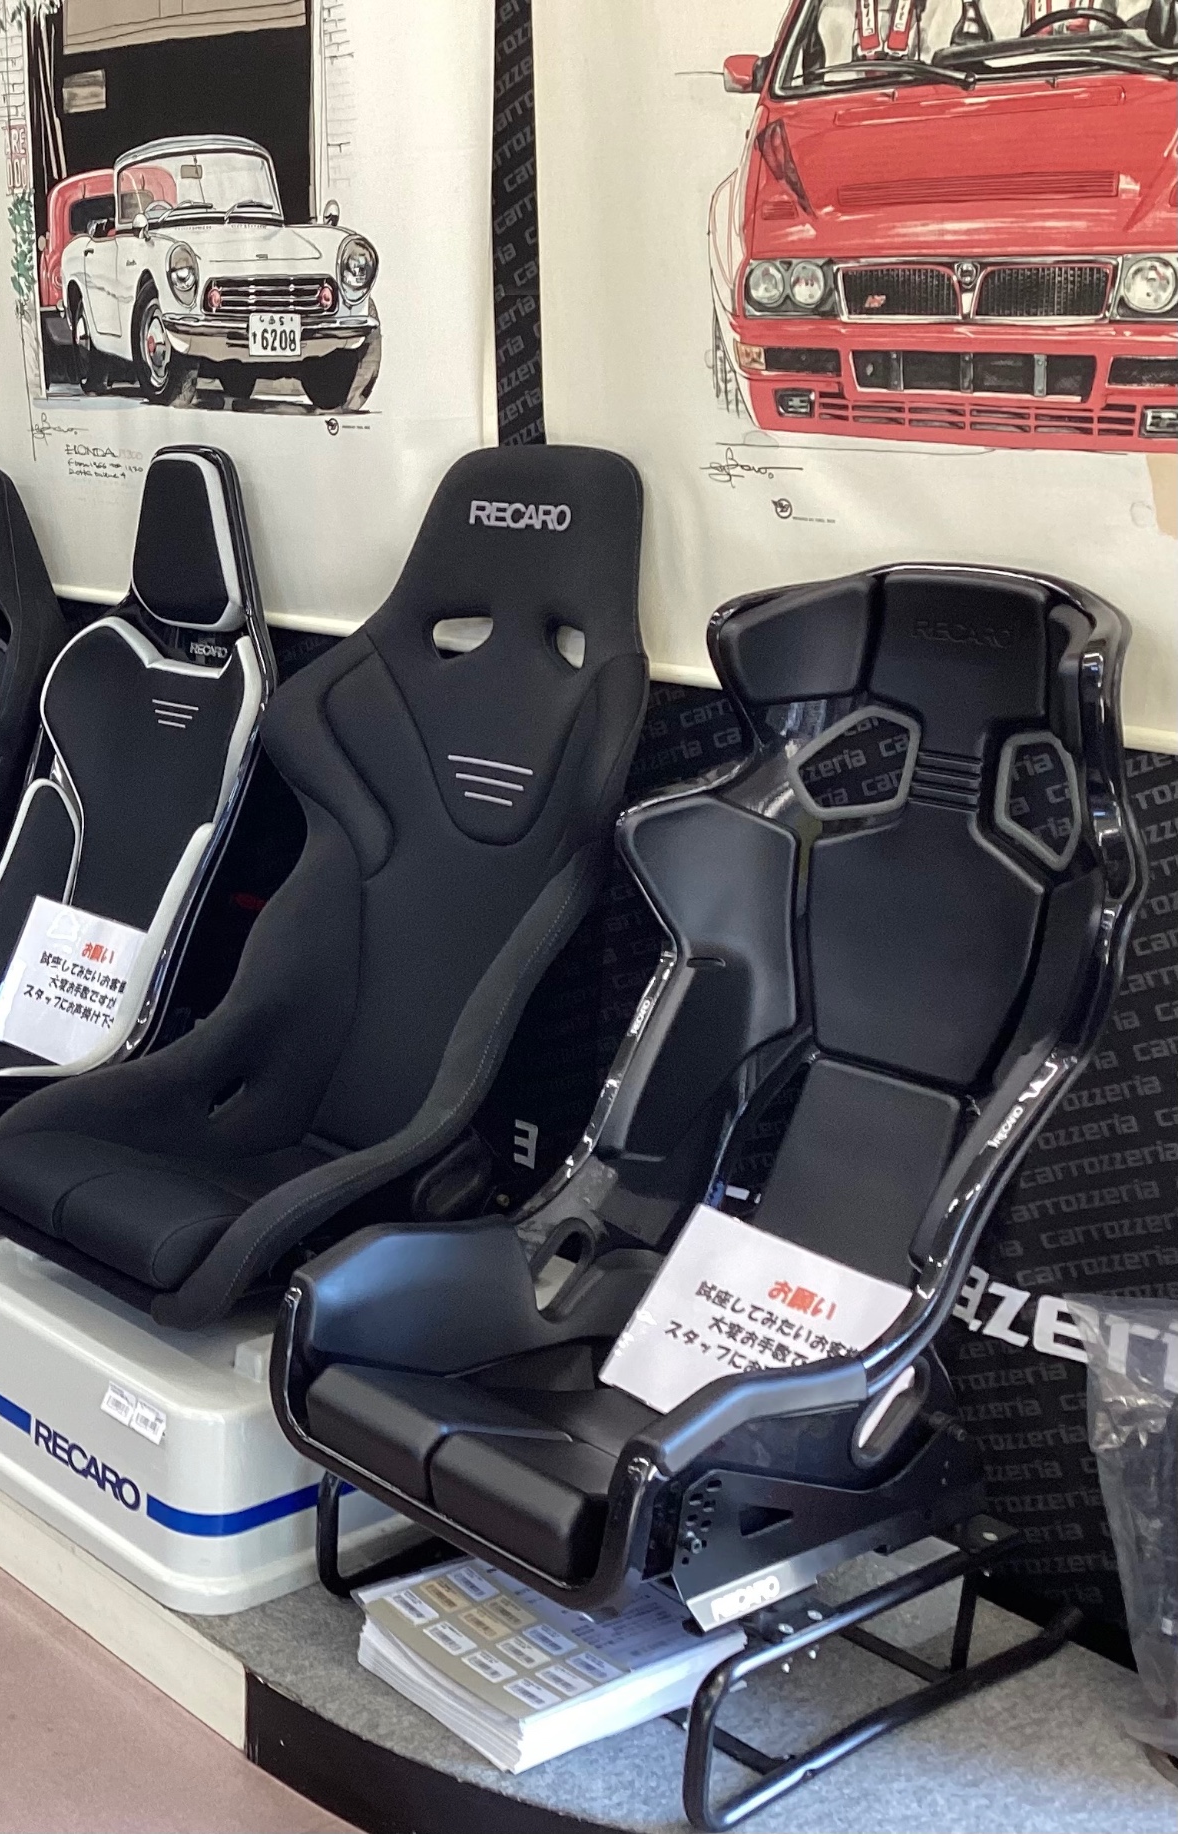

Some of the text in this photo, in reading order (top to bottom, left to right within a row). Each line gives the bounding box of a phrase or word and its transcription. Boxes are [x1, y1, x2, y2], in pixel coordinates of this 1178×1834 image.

[261, 327, 297, 352] 6208
[64, 443, 119, 458] HONDA
[468, 500, 572, 532] RECARO
[189, 641, 229, 659] RECARO
[81, 941, 116, 965] お願い
[767, 1279, 838, 1321] お願い
[664, 1320, 772, 1373] スタッフにお
[34, 1418, 141, 1511] RECARO
